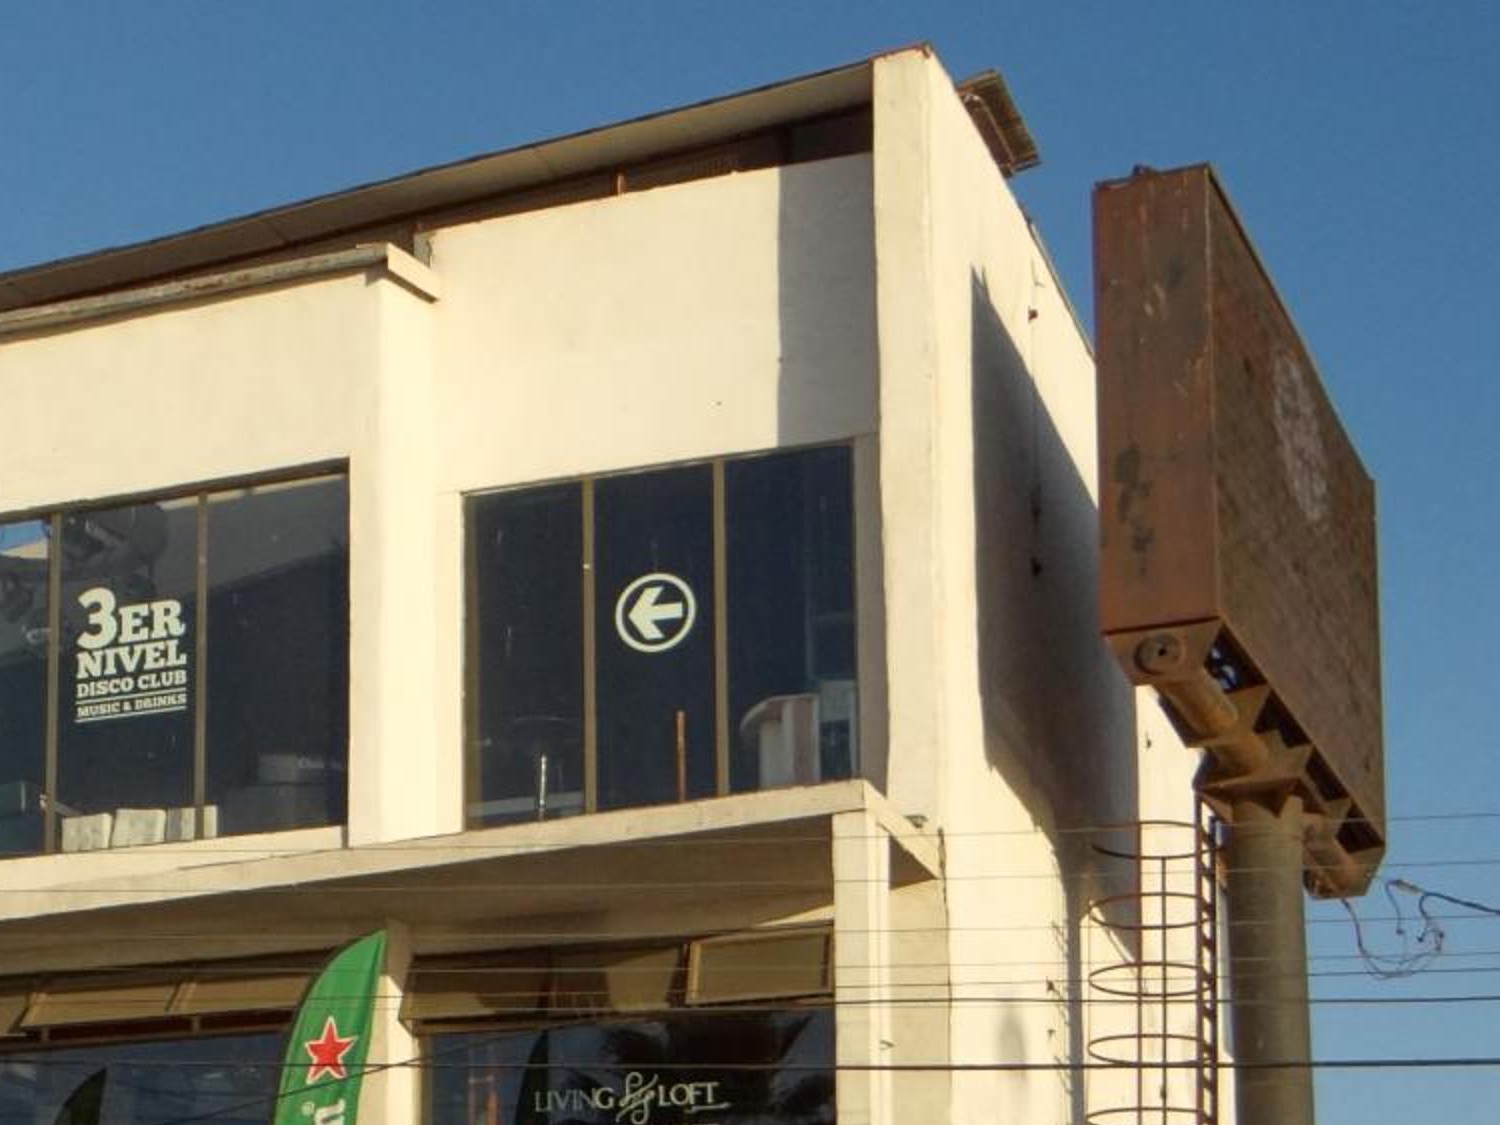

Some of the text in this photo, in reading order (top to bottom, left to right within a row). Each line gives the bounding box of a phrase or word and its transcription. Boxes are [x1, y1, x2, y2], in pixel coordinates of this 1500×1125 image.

[76, 587, 186, 649] 3ER
[76, 640, 187, 679] NIVEL
[76, 670, 187, 698] DISCO CLUB
[77, 702, 120, 717] MUSIC
[135, 694, 187, 710] DRINKS
[535, 1087, 614, 1112] LIVING
[658, 1081, 721, 1107] LOFT
